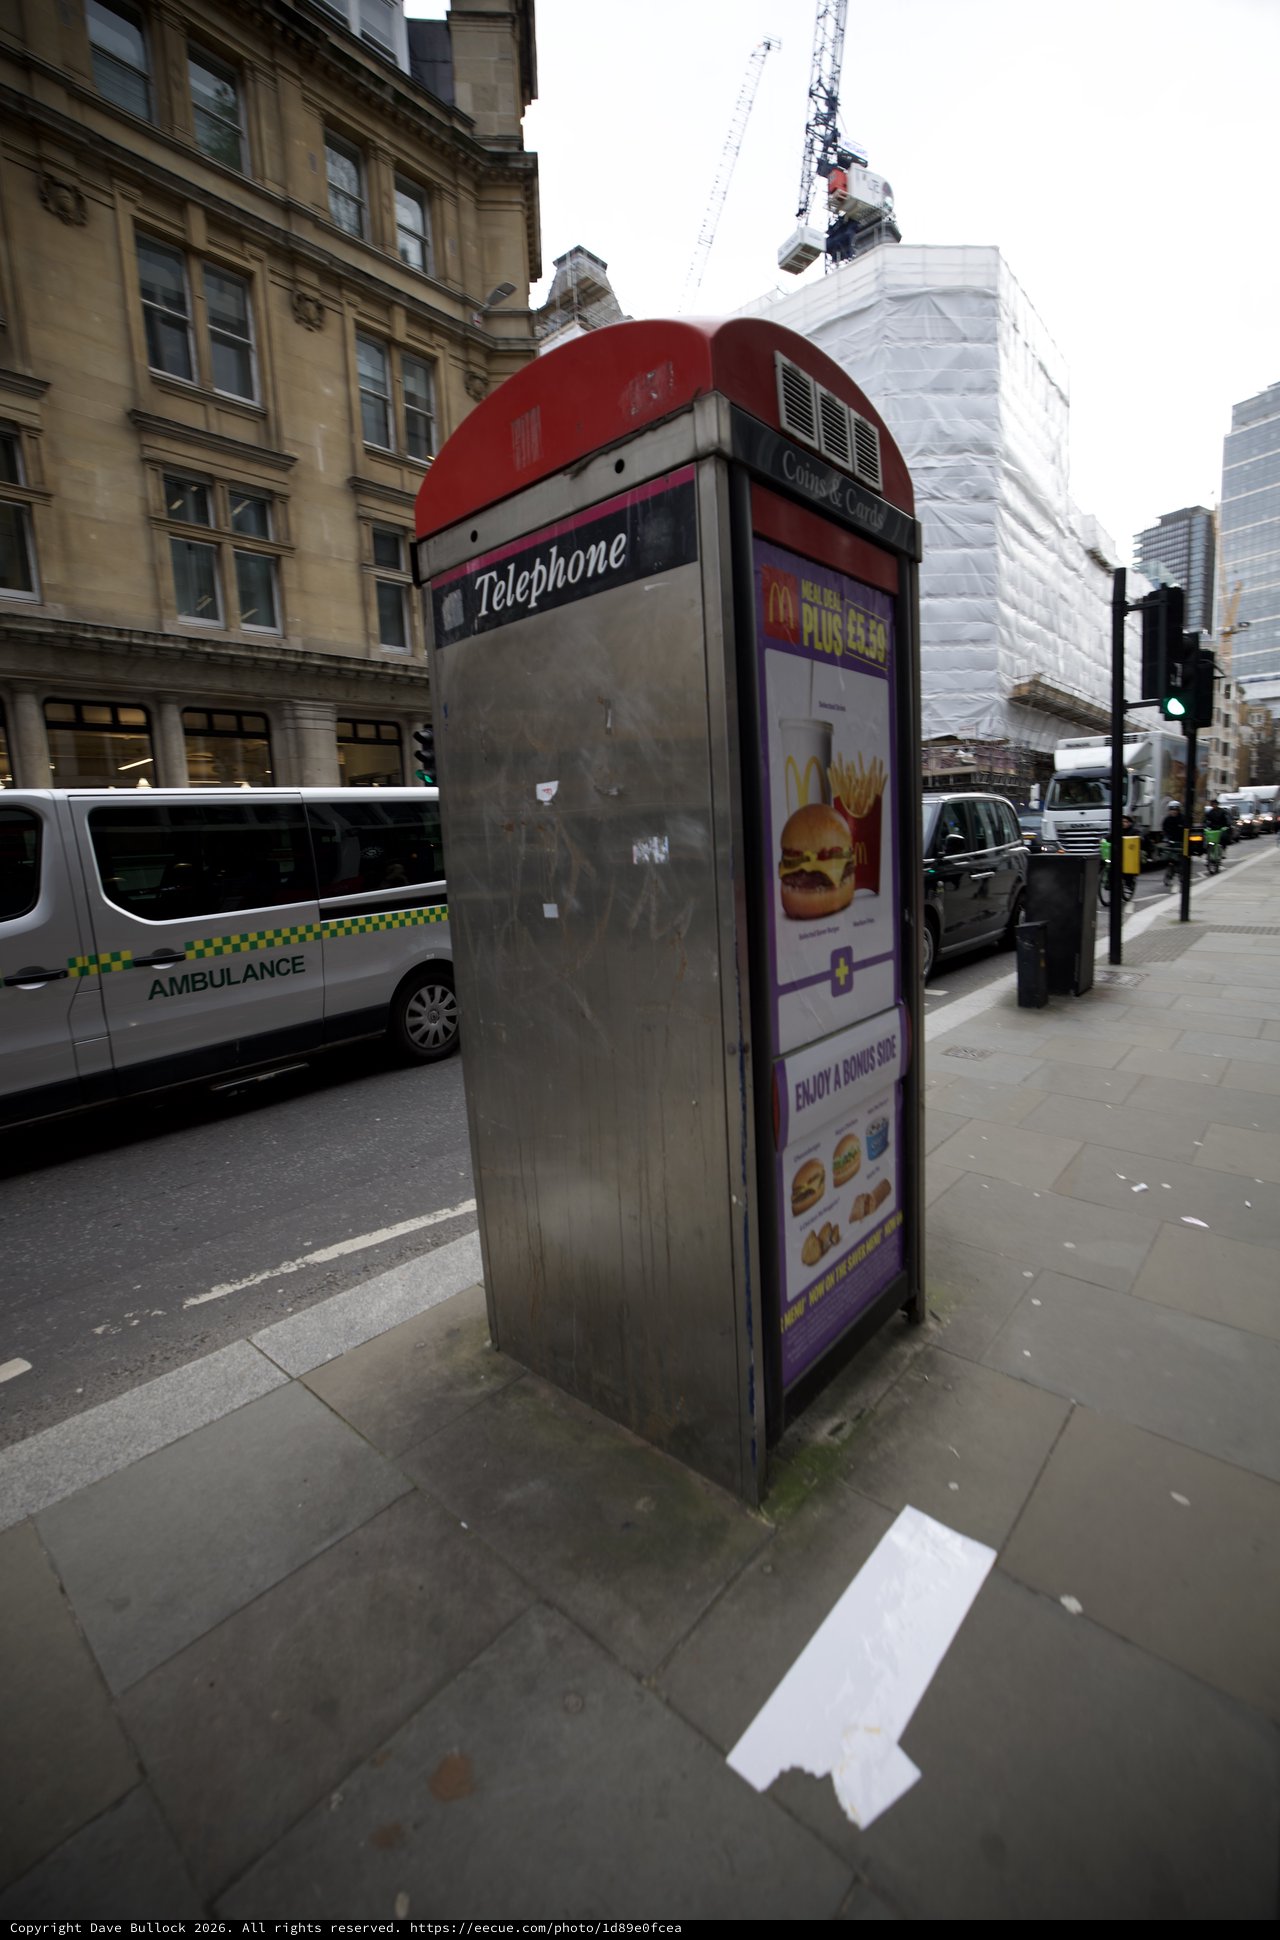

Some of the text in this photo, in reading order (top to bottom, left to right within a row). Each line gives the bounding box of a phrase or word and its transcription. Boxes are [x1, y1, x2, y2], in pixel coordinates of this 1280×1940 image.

[783, 450, 885, 529] Coins & Cards
[474, 532, 627, 617] Telephone
[801, 578, 842, 612] MEAL DEAL
[801, 602, 844, 657] PLUS
[846, 608, 887, 664] £5.59
[148, 955, 306, 1001] AMBULANCE
[795, 1067, 833, 1112] ENJOY
[834, 1064, 842, 1091] A
[843, 1045, 876, 1087] BONUS
[876, 1034, 897, 1069] SIDE
[808, 1279, 825, 1307] NOW
[825, 1270, 835, 1292] ON
[835, 1260, 847, 1282] THE
[847, 1244, 866, 1272] SAVER
